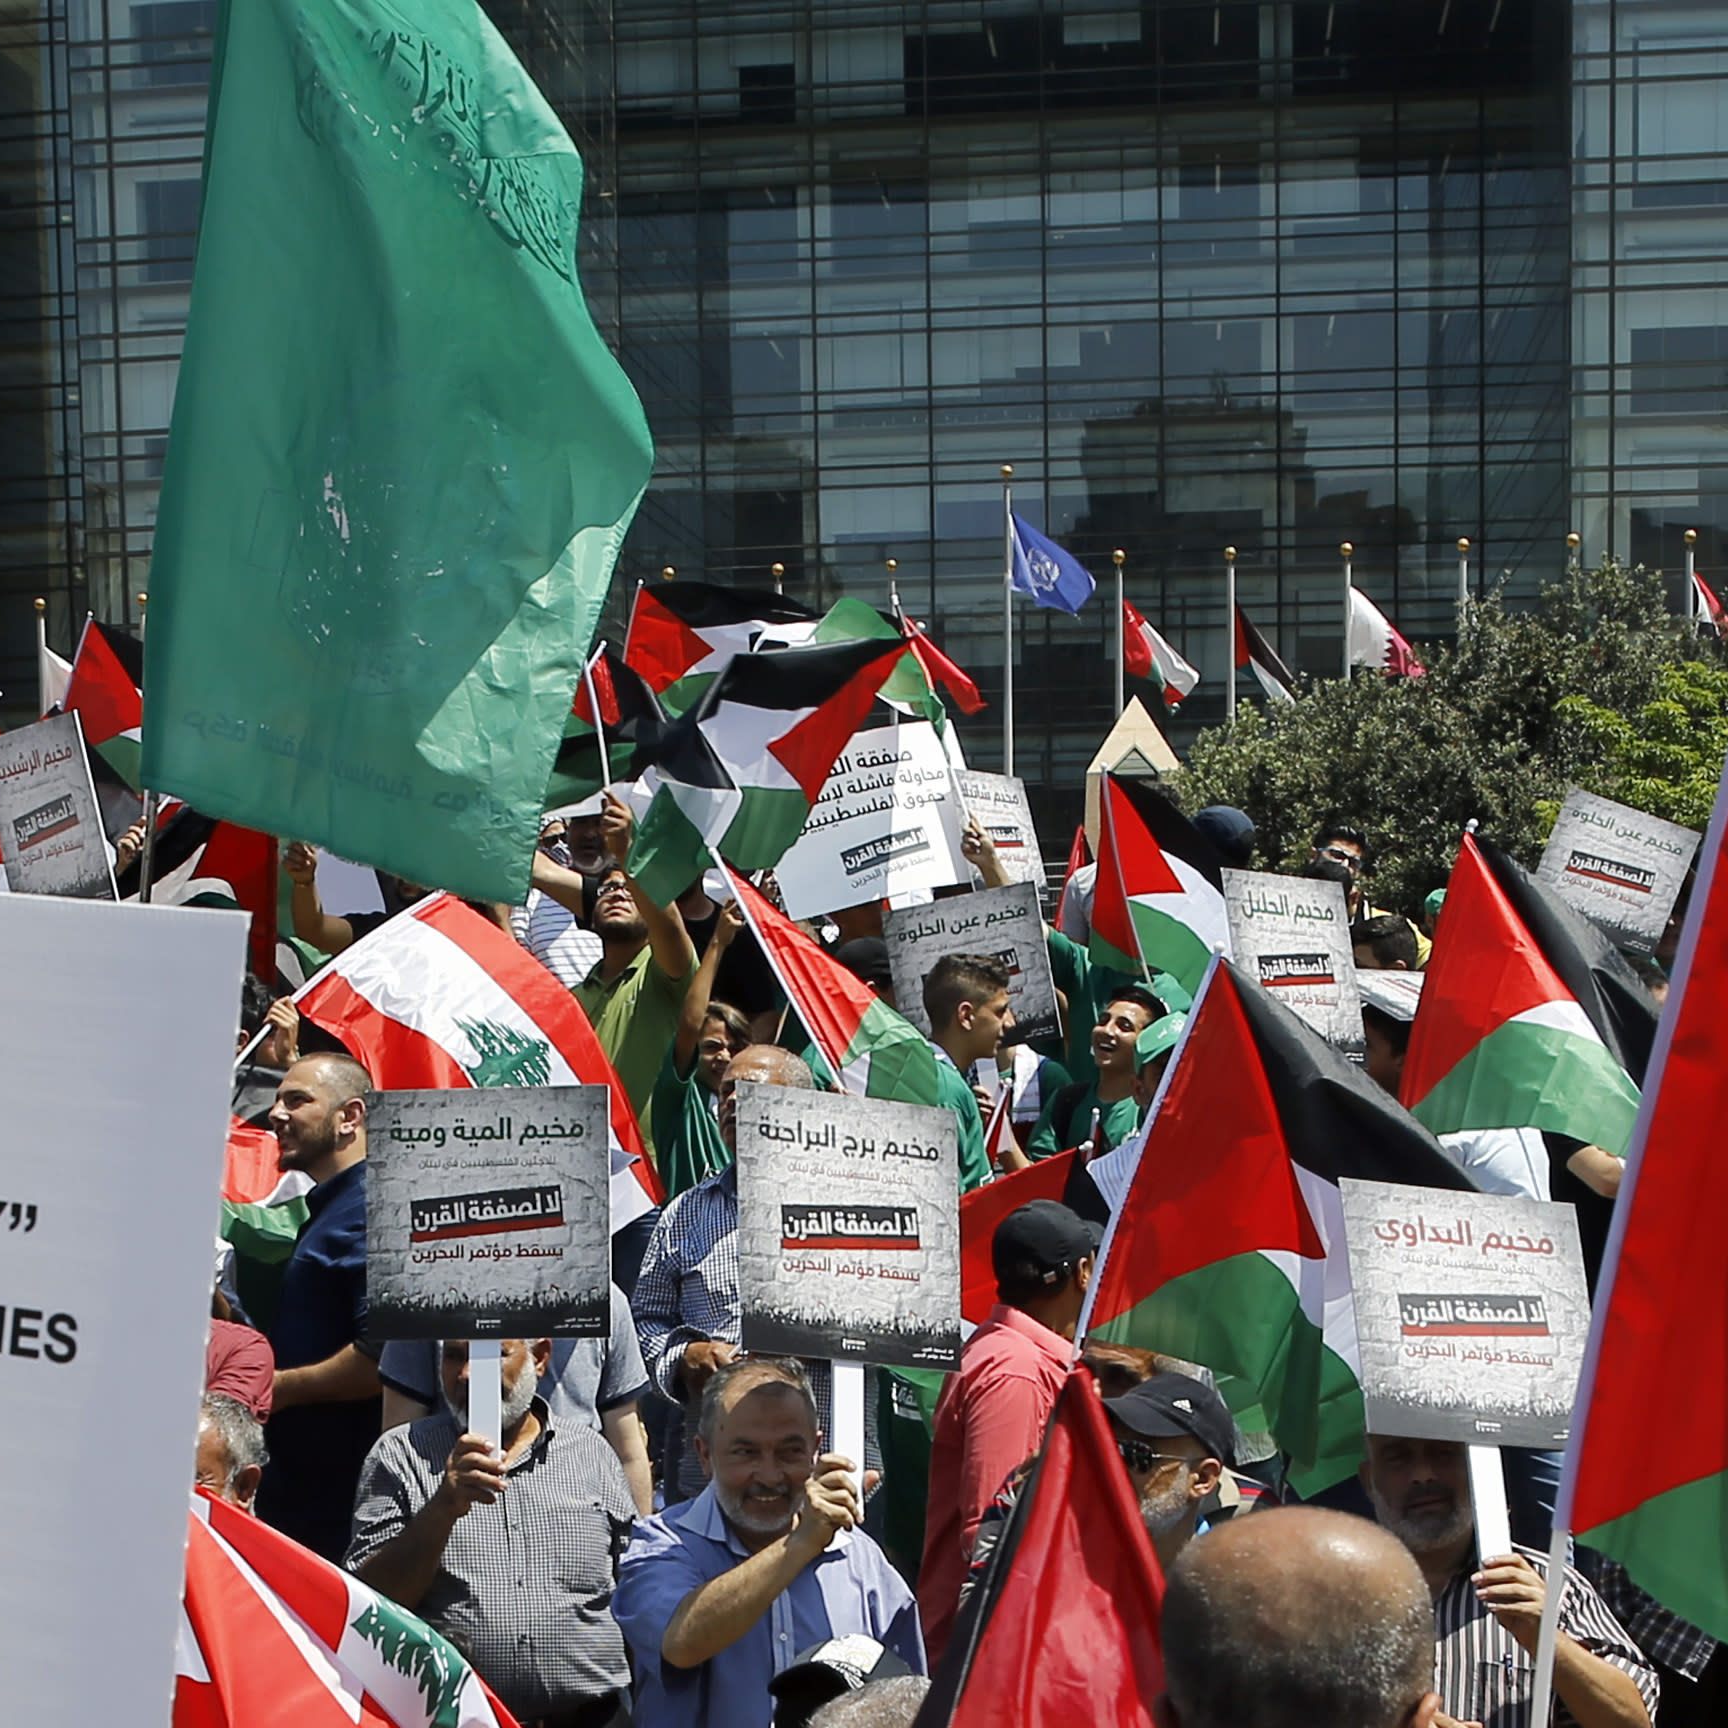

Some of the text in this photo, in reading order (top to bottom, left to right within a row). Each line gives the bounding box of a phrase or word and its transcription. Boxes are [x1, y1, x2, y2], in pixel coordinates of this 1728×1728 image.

[856, 748, 912, 769] صفقة
[848, 774, 895, 794] فاشلة
[899, 768, 944, 782] محاولة
[904, 791, 944, 808] حقوق
[1644, 838, 1683, 855] مخيم
[985, 905, 1027, 928] مخيم
[1241, 890, 1335, 928] مخيم الجليل
[950, 914, 980, 935] عين
[389, 1116, 585, 1150] مخيم المية ومية
[758, 1114, 940, 1166] مخيم برج البراجنة
[413, 1189, 561, 1233] لا لصفقة القرن
[783, 1210, 918, 1242] لا لصفقة القرن
[1373, 1214, 1555, 1262] مخيم البداوي
[412, 1242, 563, 1264] يسقط مؤتمر البحرين
[782, 1255, 921, 1284] يسقط مؤتمر البحرين
[1401, 1298, 1545, 1329] لا لصفقة القرن
[1404, 1342, 1554, 1370] يسقط مؤتمر البحرين
